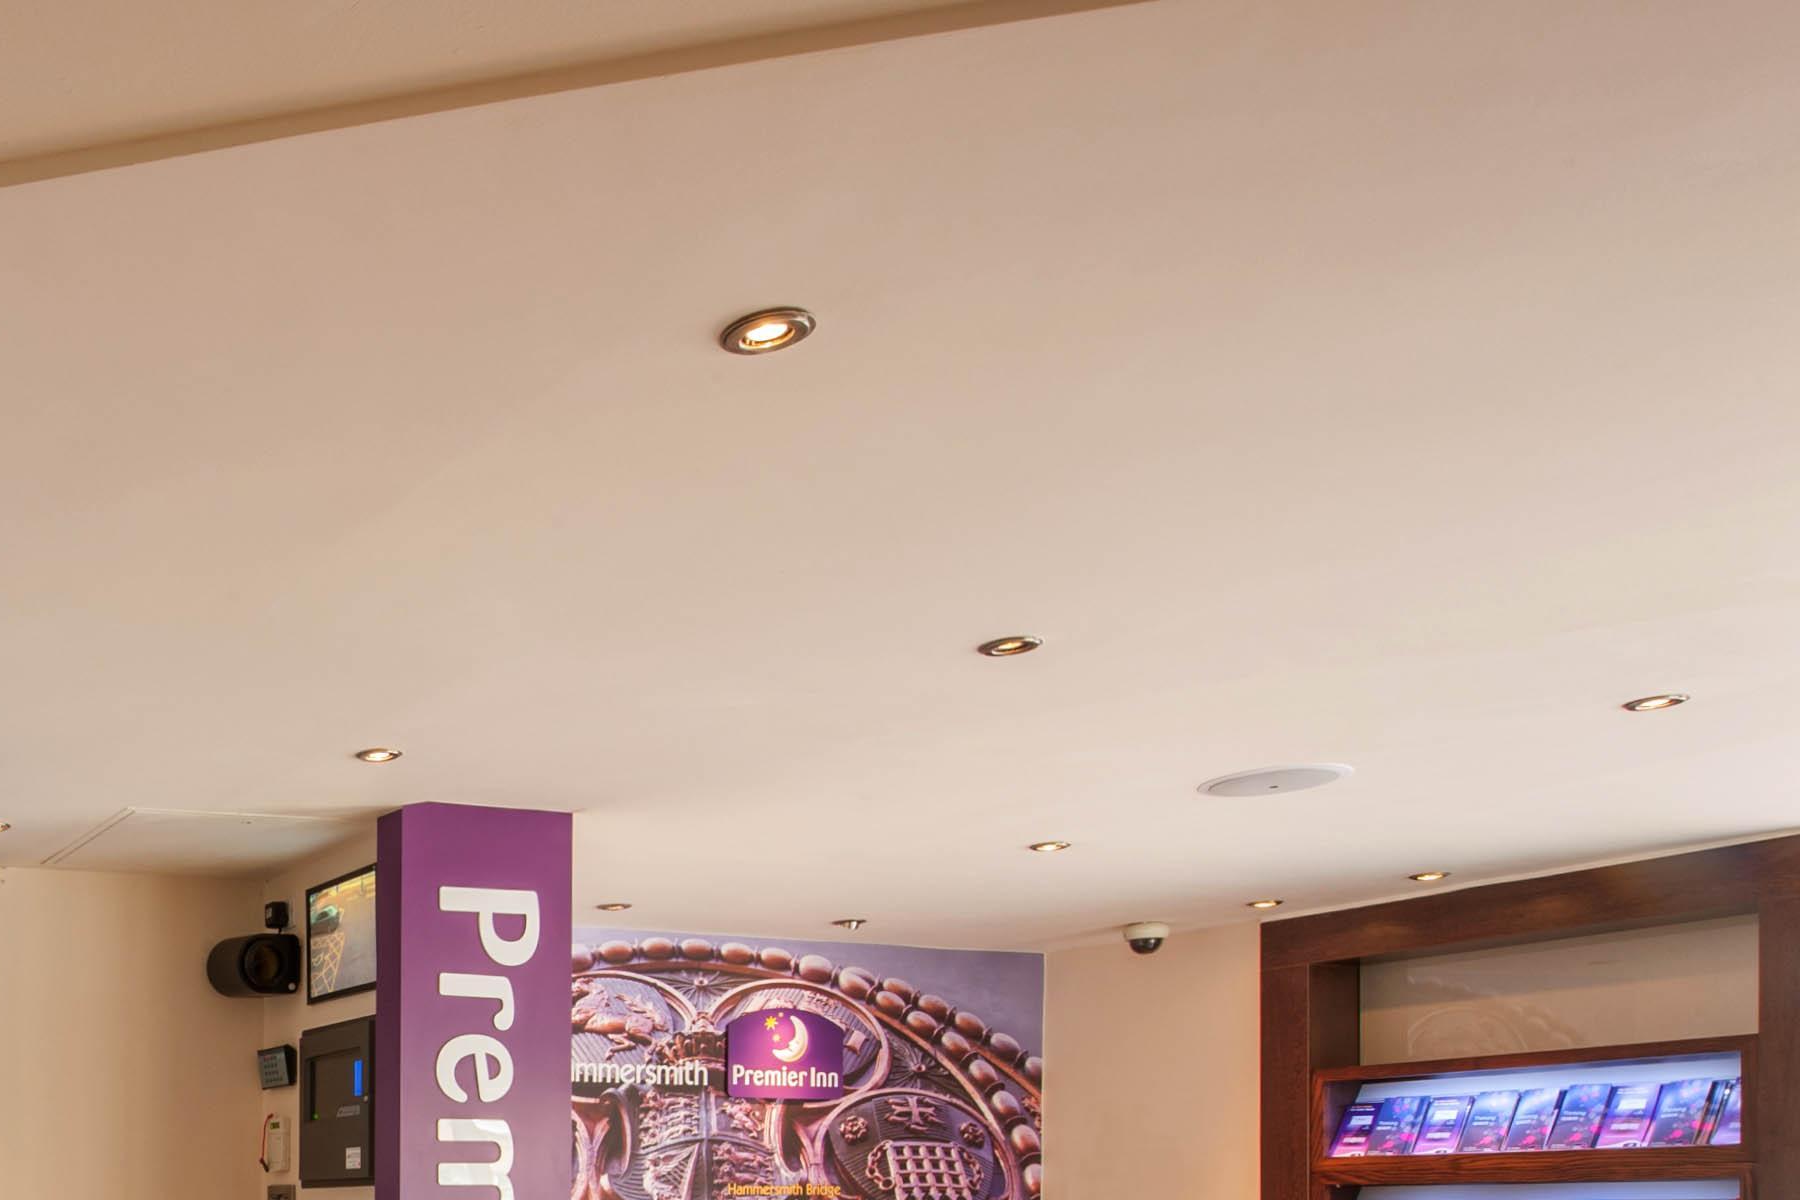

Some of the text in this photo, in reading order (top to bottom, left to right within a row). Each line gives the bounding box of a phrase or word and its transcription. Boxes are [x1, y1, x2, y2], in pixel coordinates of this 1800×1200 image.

[732, 1064, 839, 1089] Premier Inn
[728, 1183, 841, 1198] Hammersmith Bridge
